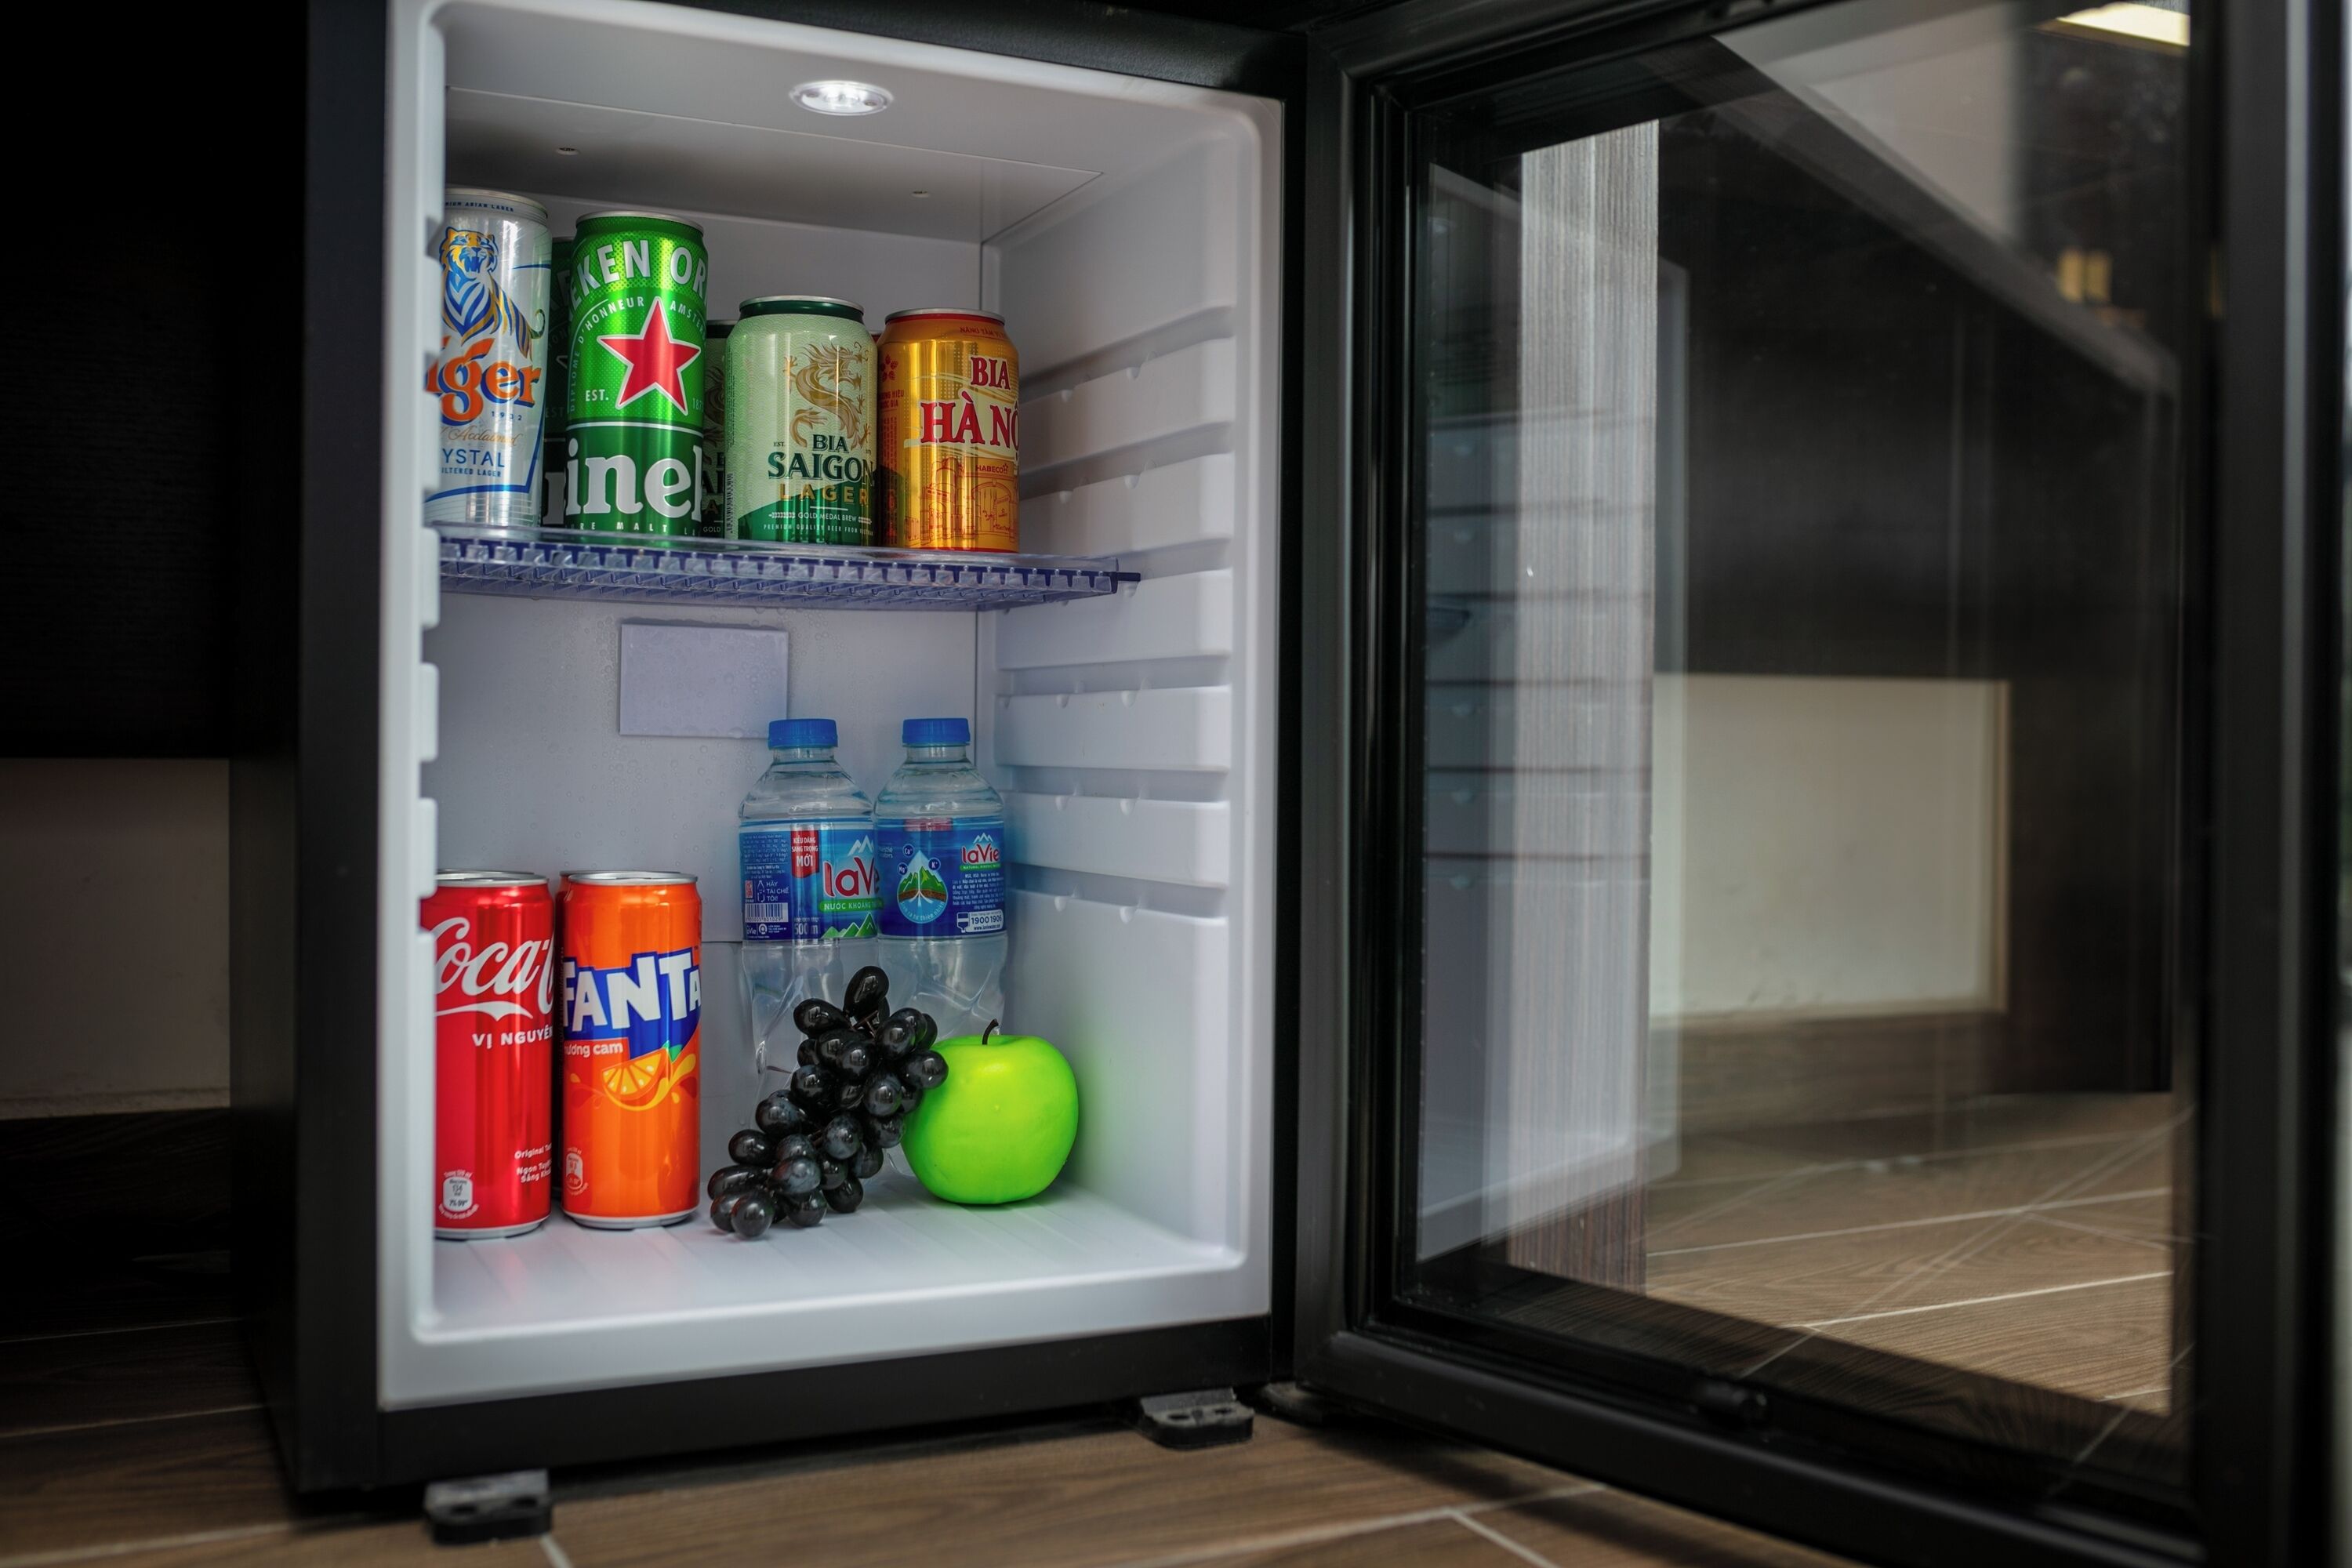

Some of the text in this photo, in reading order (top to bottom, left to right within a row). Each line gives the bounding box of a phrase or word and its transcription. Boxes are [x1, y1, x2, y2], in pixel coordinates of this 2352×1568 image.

[970, 356, 1011, 390] BIA
[585, 389, 609, 401] EST.
[920, 390, 985, 445] HÀ
[812, 434, 849, 453] BIA
[477, 469, 501, 477] LAGER
[768, 451, 874, 487] SAIGON
[779, 483, 869, 507] LAGER
[616, 521, 667, 533] MALT
[971, 916, 989, 924] 1900
[563, 952, 702, 1033] FANTA
[472, 1033, 492, 1049] VỊ
[593, 1042, 624, 1055] cam
[514, 1146, 544, 1160] Original
